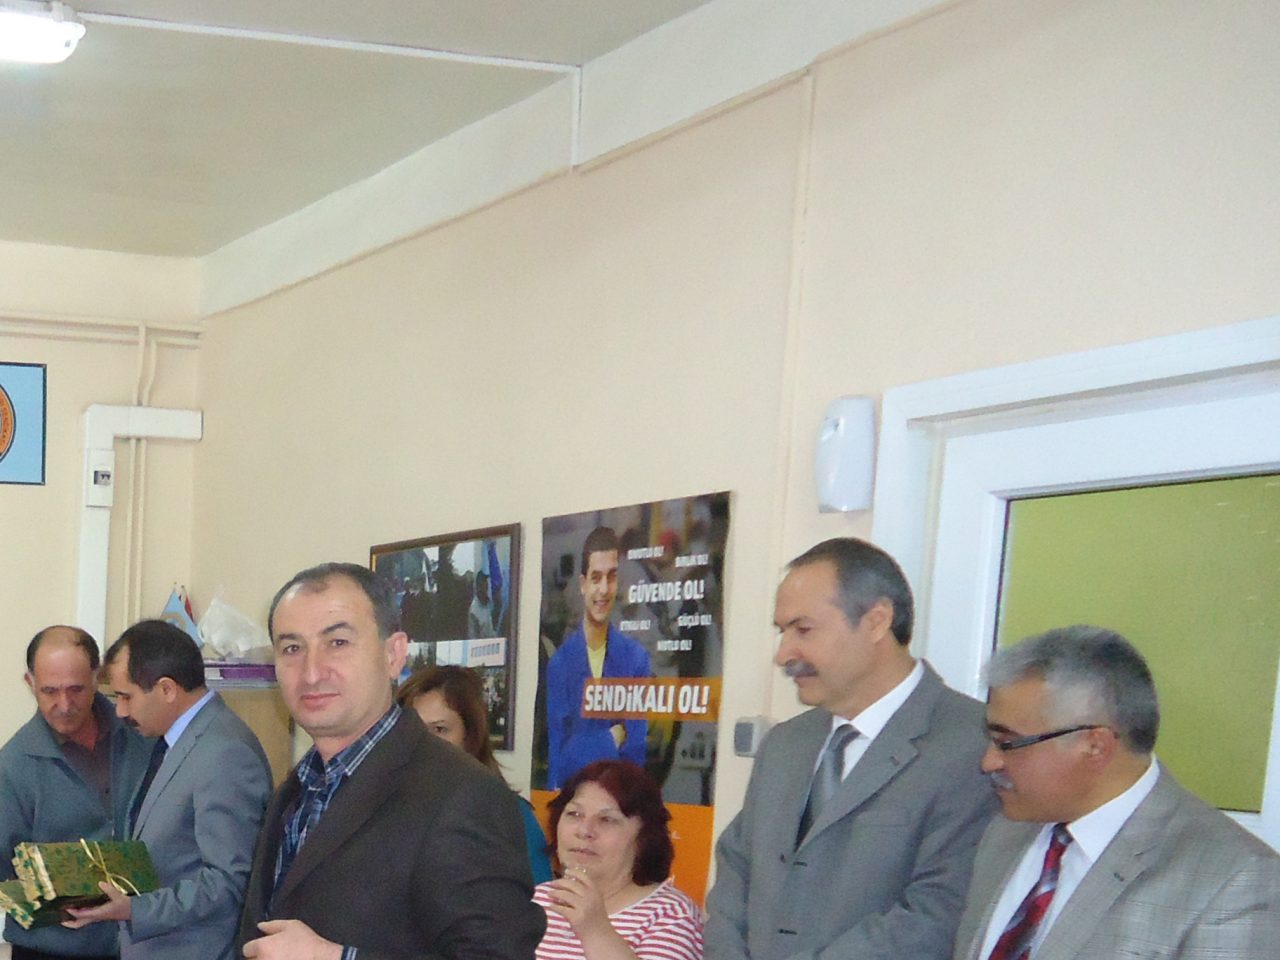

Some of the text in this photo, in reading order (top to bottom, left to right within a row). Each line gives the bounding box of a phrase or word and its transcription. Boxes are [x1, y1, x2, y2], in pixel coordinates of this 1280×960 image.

[628, 579, 705, 604] GÜVENDE OL!
[680, 640, 693, 651] OL!
[678, 684, 710, 714] OL!
